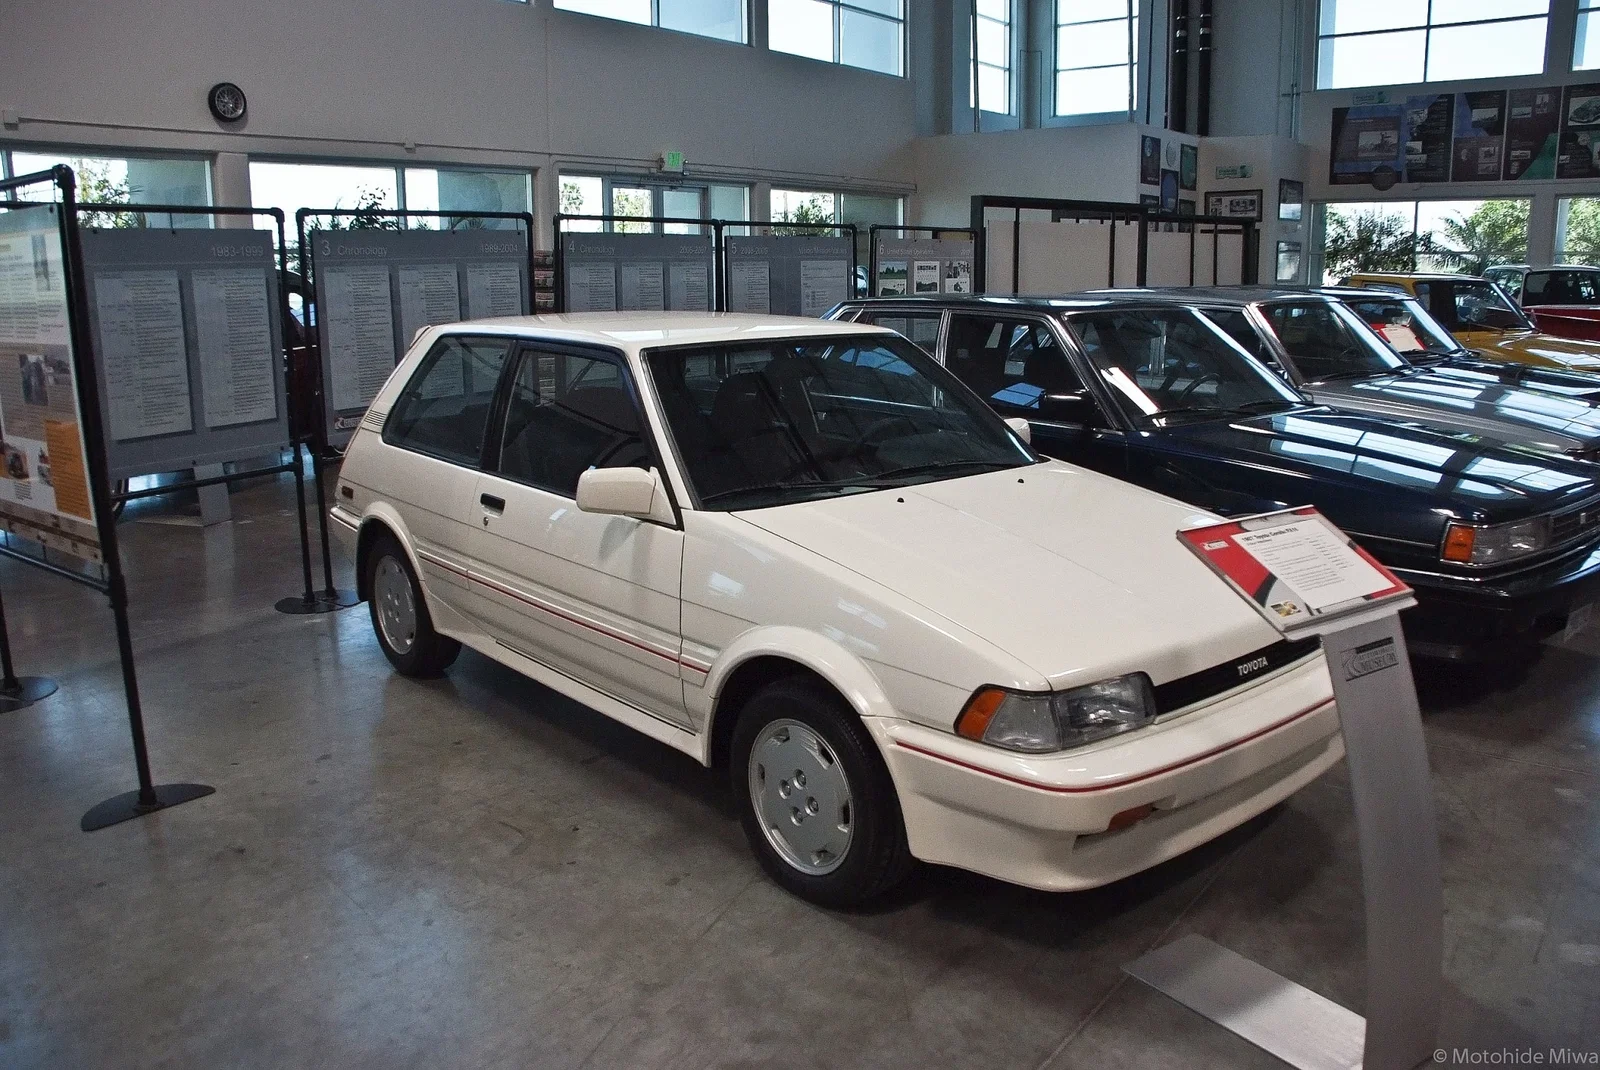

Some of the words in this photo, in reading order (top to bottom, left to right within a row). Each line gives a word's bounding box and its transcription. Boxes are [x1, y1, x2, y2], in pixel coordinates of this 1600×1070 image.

[210, 245, 264, 257] 1983-1999
[321, 239, 331, 256] 3
[337, 244, 388, 257] Chronology
[568, 240, 576, 253] 4
[731, 242, 738, 255] 5
[879, 243, 885, 255] 6
[1237, 656, 1269, 676] TOYOTA
